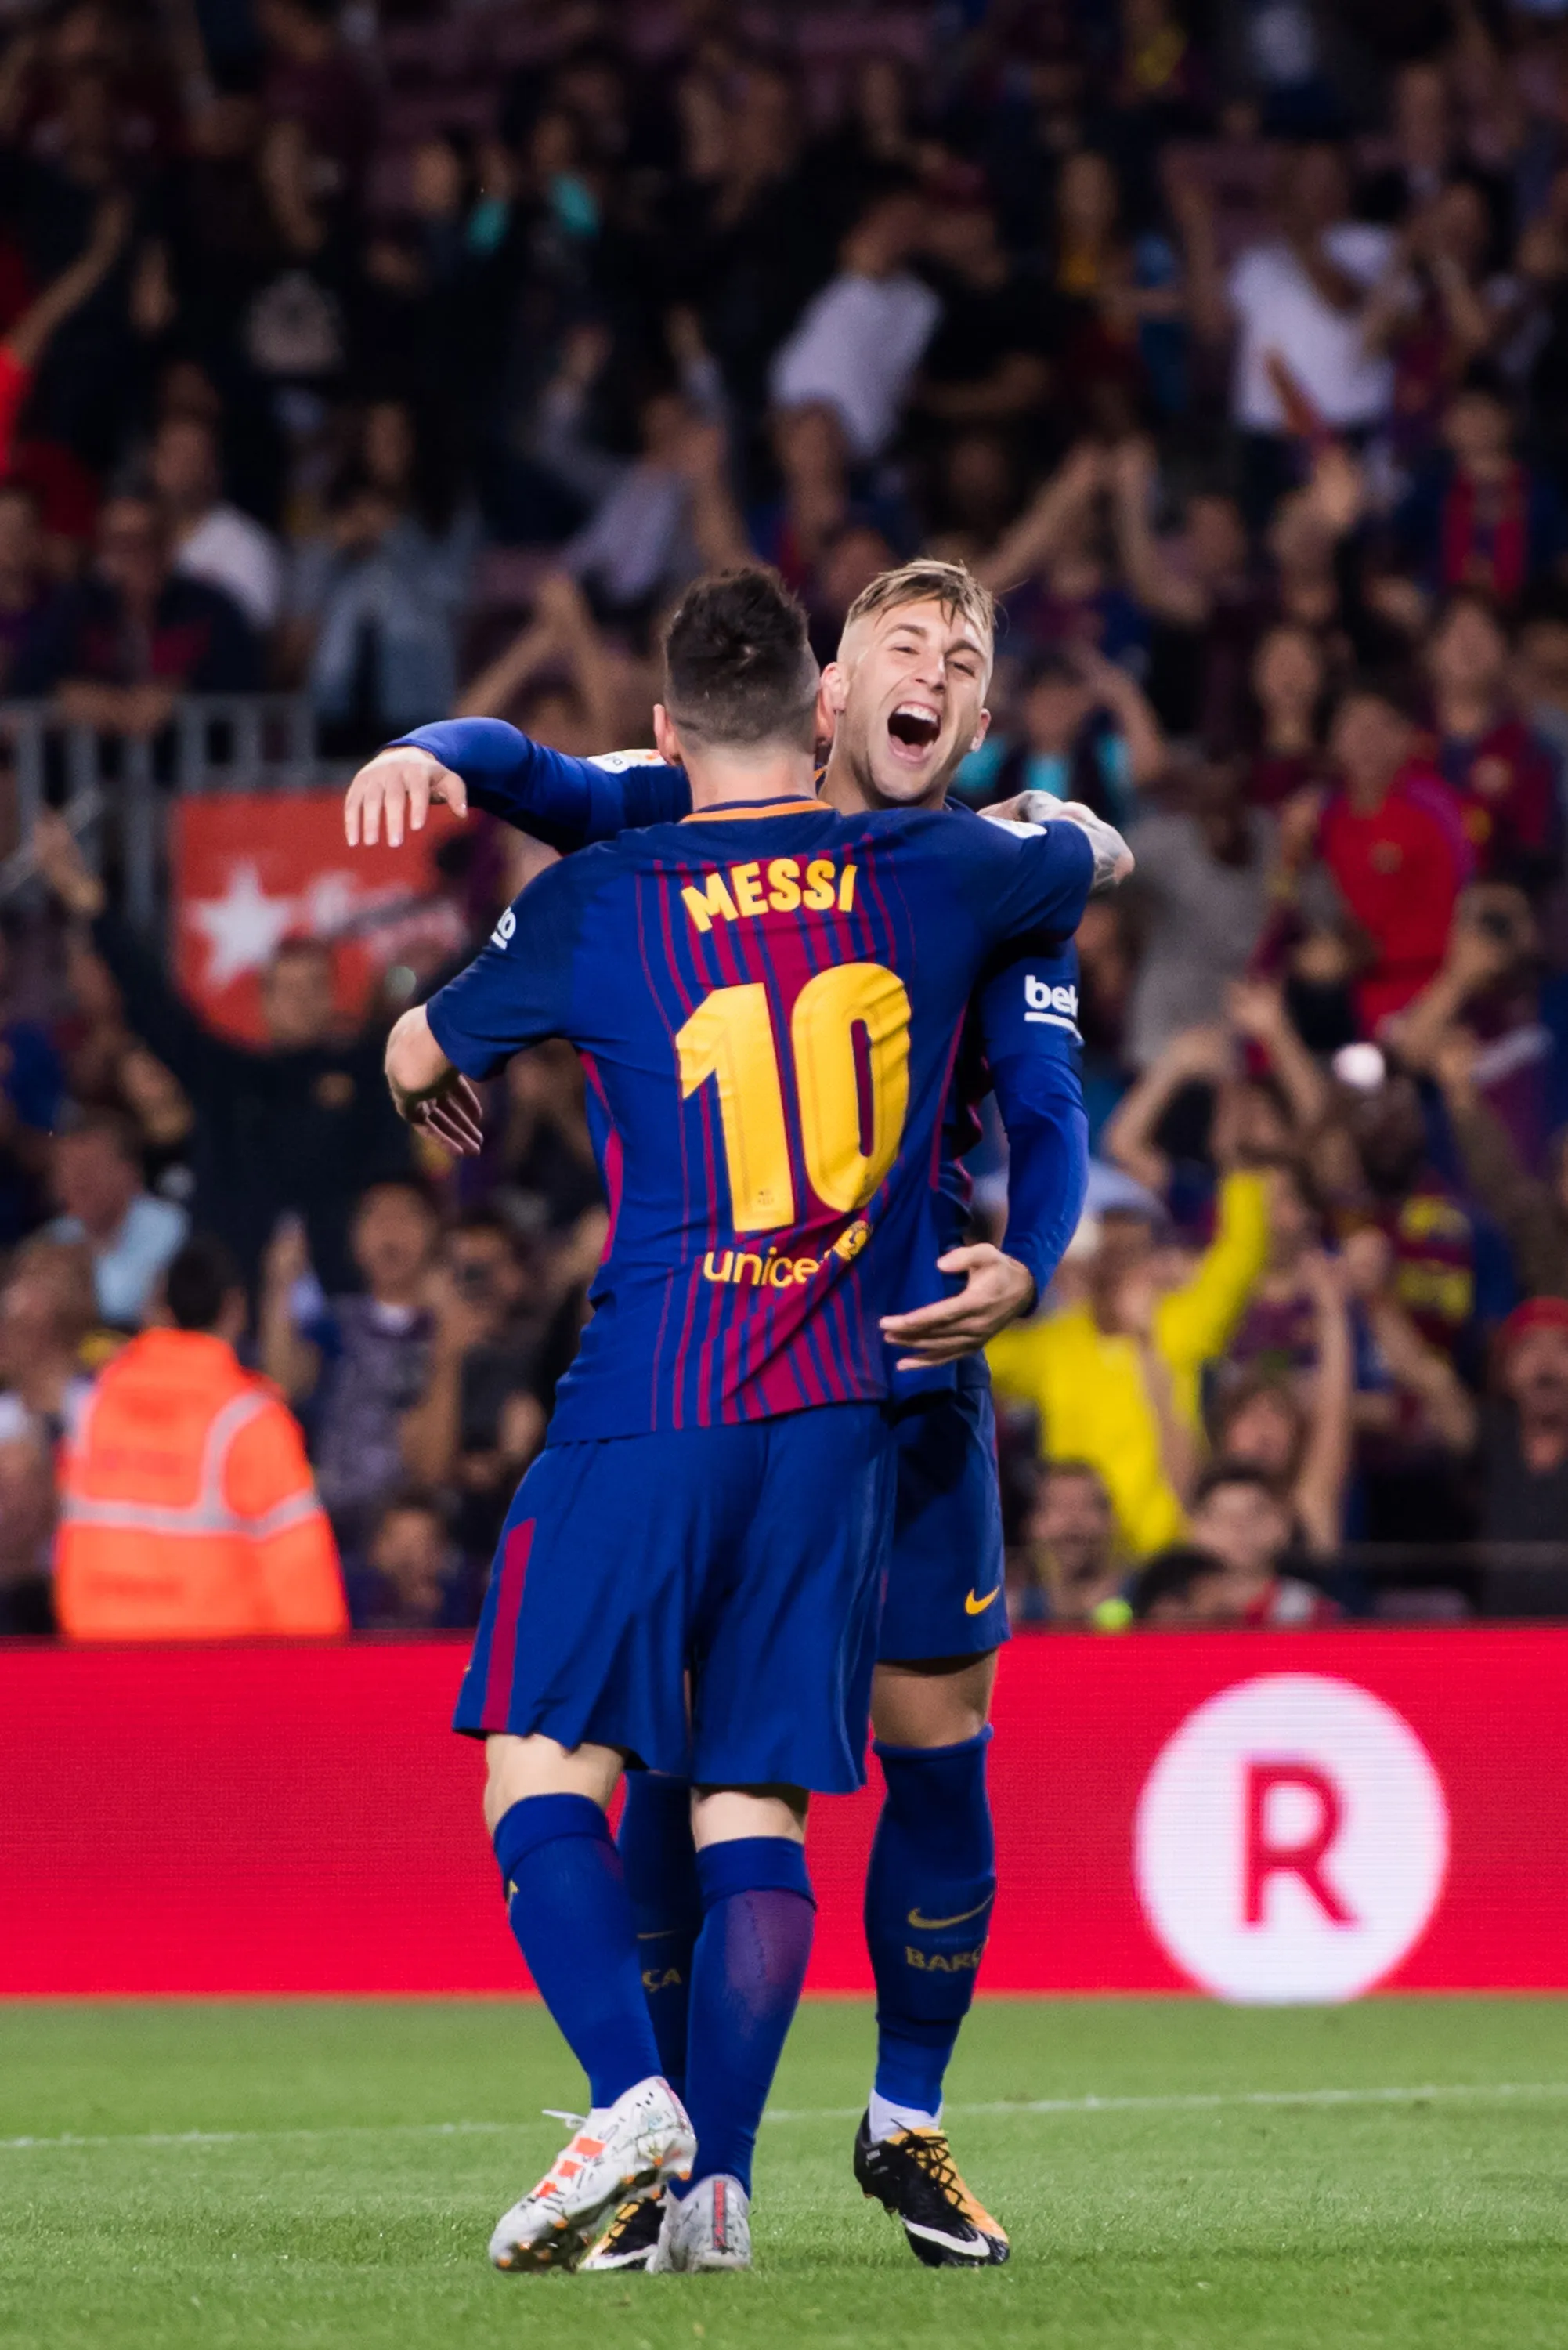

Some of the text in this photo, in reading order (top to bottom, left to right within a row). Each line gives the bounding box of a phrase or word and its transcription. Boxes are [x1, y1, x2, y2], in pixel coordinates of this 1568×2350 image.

[681, 858, 858, 933] MESSI
[675, 962, 912, 1232] 10
[1244, 1759, 1360, 1924] R
